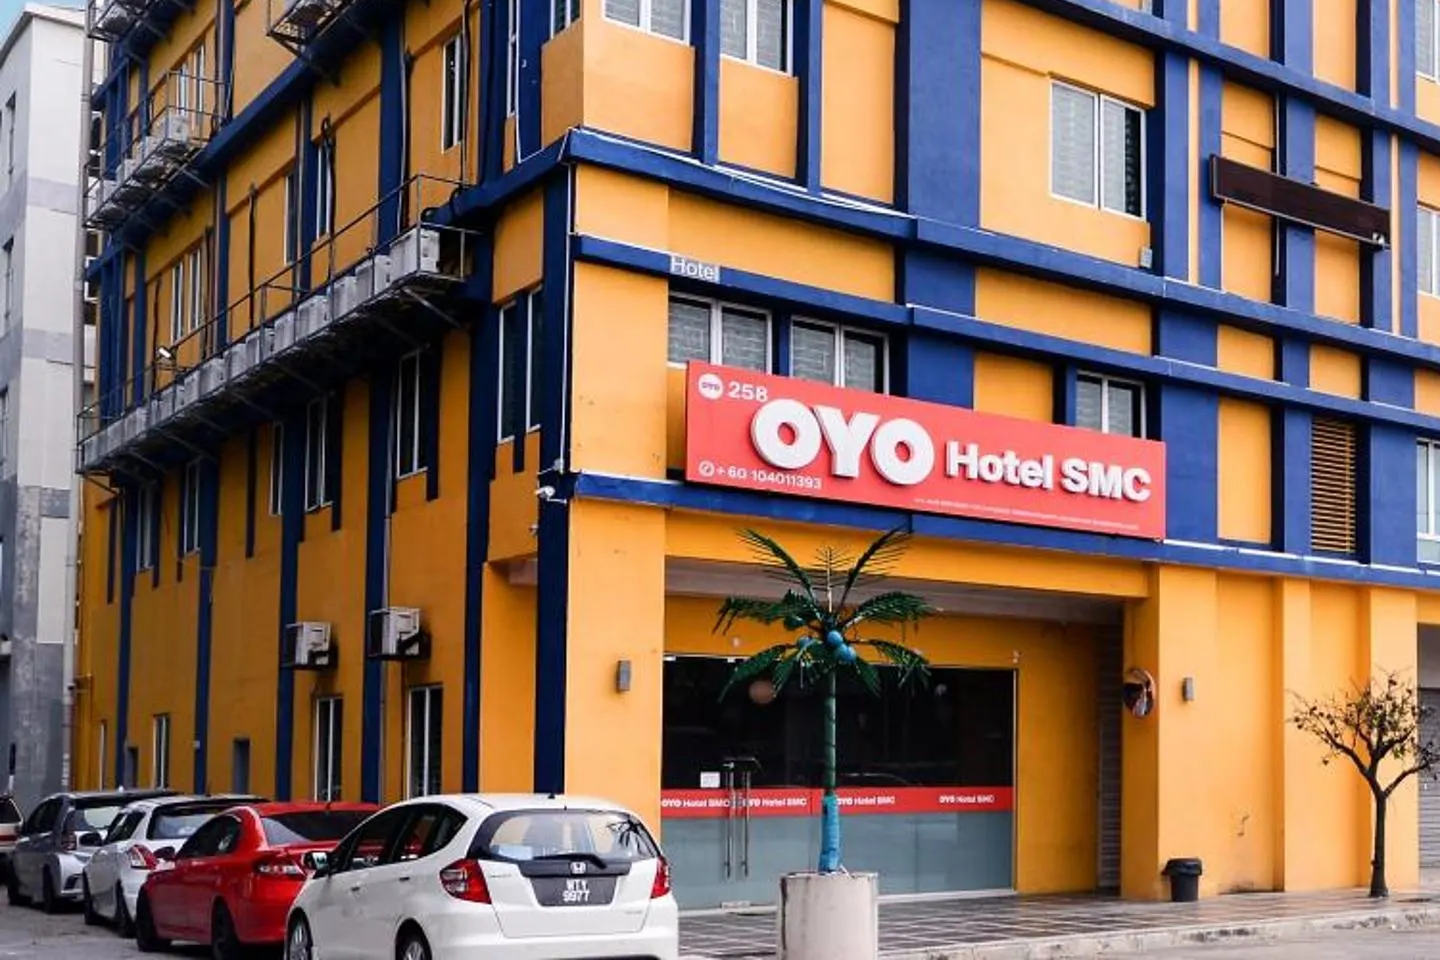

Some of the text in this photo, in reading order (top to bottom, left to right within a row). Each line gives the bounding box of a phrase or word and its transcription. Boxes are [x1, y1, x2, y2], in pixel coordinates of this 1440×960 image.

[671, 256, 720, 284] Hotel
[728, 380, 768, 401] 258
[751, 399, 1151, 502] OYO Hotel SMC
